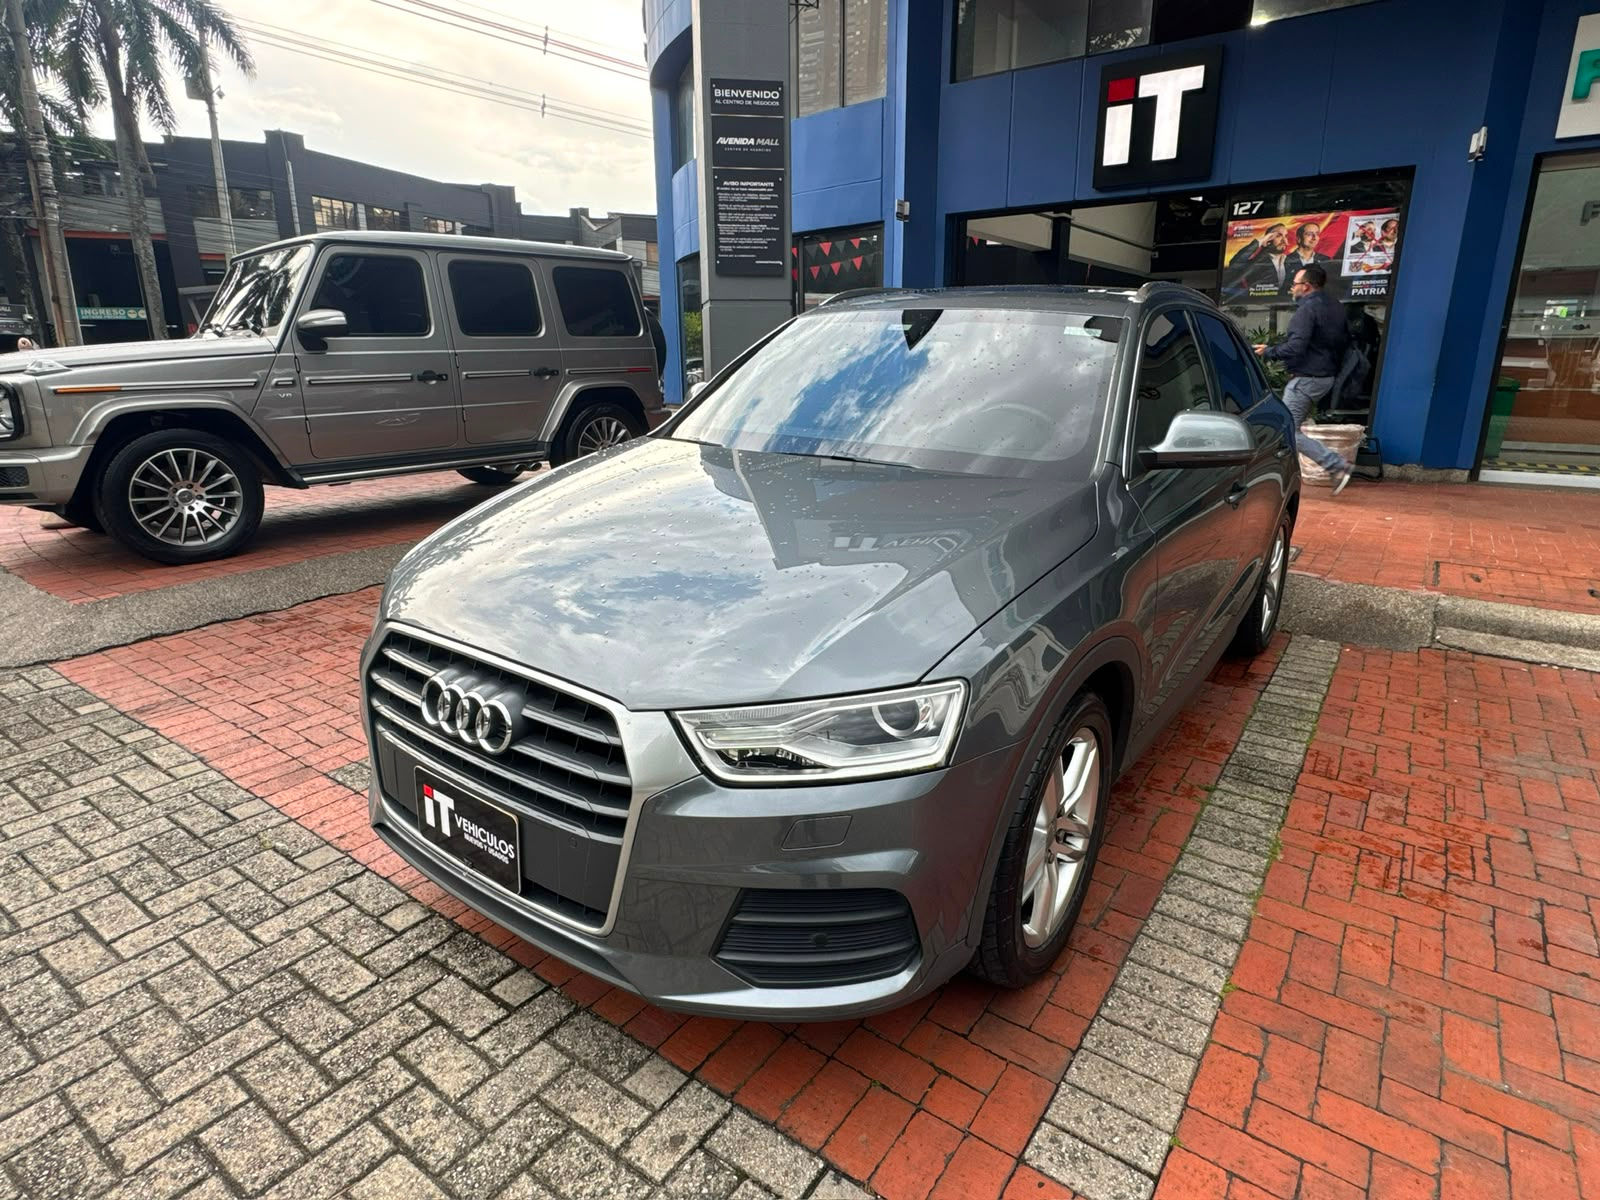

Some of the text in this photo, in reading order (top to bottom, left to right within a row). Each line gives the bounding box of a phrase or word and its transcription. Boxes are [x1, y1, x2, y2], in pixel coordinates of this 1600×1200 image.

[714, 88, 780, 99] BIENVENIDO
[716, 137, 779, 146] AVENIDA MALL
[1233, 200, 1264, 216] 127
[1351, 287, 1387, 296] PATRIA
[80, 308, 126, 316] INGRESO
[454, 813, 515, 859] VEHICULOS
